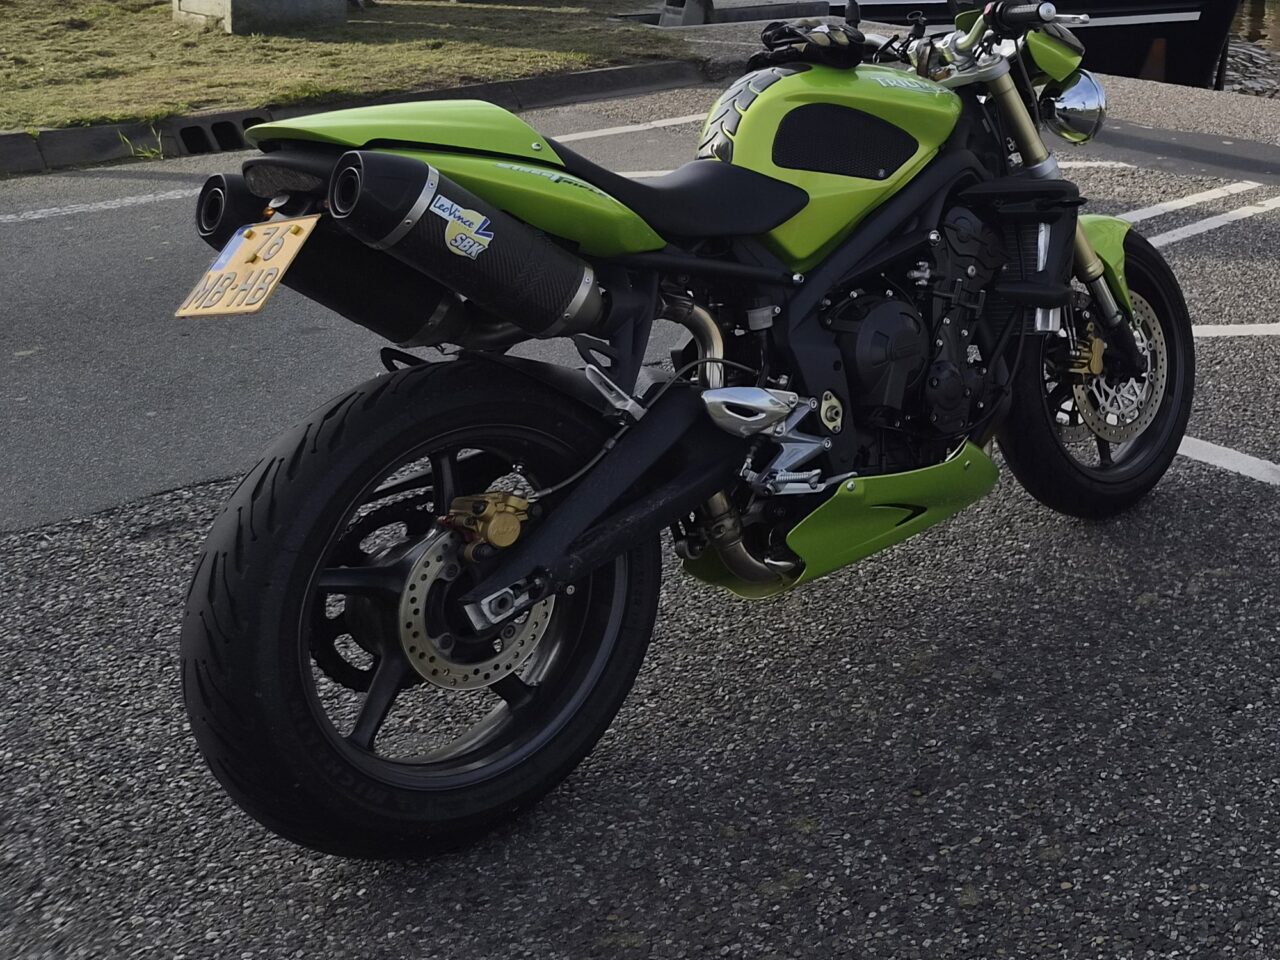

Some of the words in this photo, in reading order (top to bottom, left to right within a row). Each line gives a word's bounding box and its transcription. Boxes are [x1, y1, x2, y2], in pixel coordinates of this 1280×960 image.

[433, 196, 475, 229] LeoVince
[246, 224, 293, 263] 76
[450, 232, 486, 259] SBK
